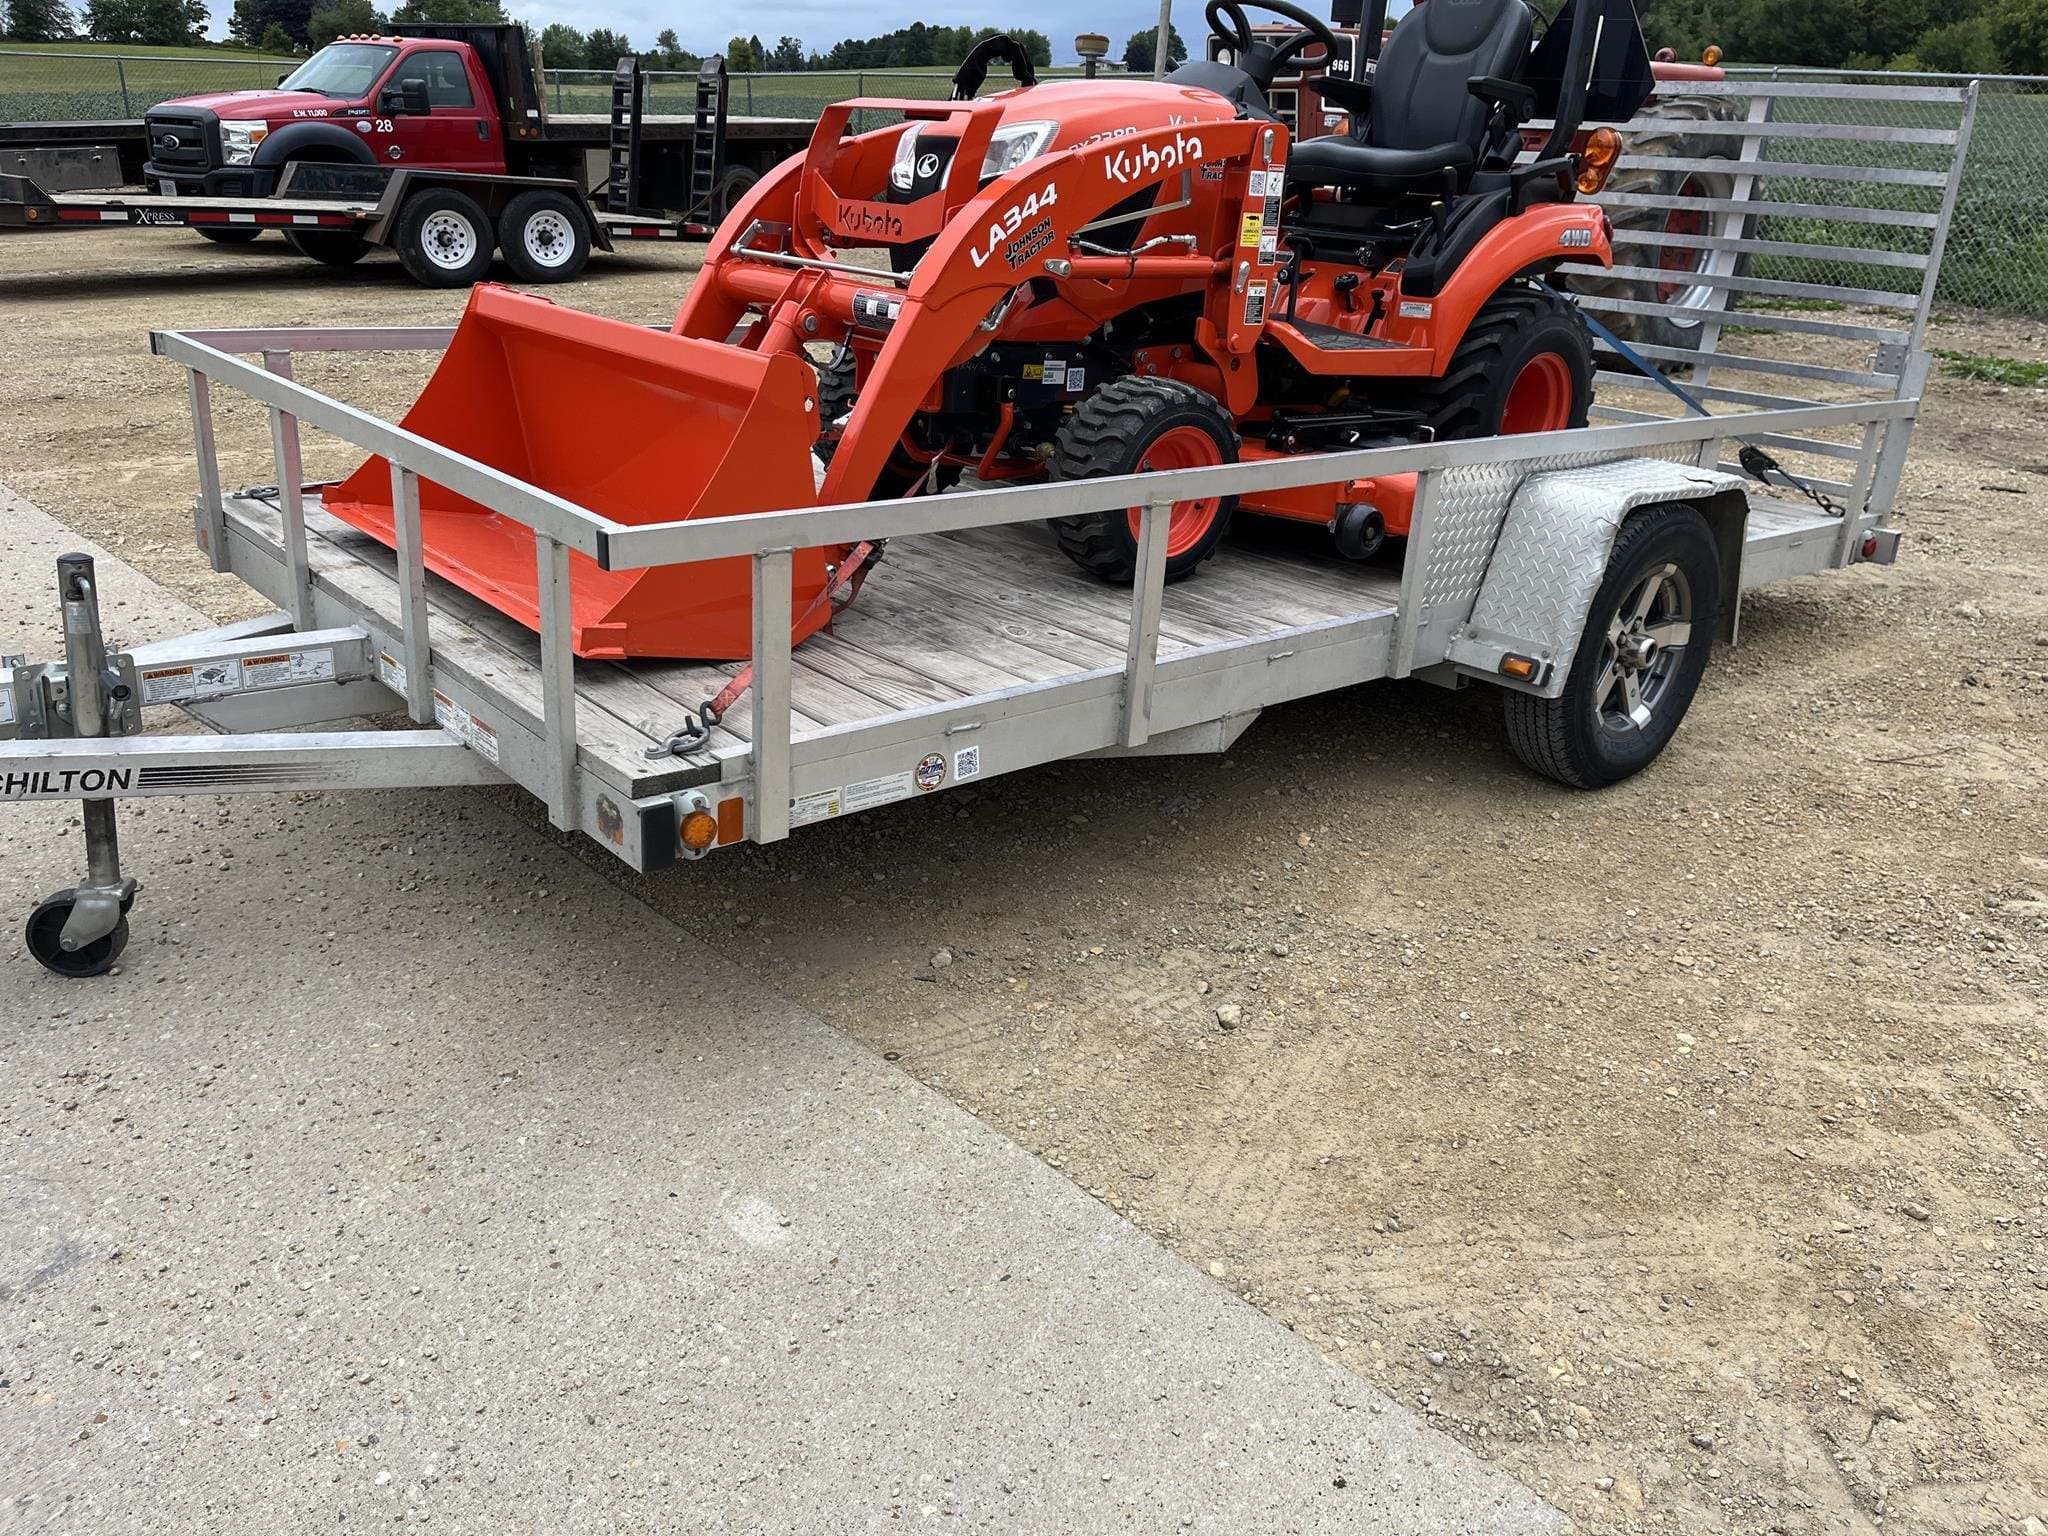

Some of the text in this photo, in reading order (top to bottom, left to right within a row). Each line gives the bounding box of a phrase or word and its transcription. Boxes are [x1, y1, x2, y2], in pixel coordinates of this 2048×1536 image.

[1332, 59, 1350, 72] 966
[375, 119, 394, 133] 28
[1104, 132, 1203, 183] Kubota
[838, 204, 904, 237] Kubota
[970, 182, 1058, 268] LA344
[1005, 216, 1051, 259] JOHNSON
[1008, 231, 1055, 271] TRACTOR
[1558, 228, 1592, 247] 4WD
[0, 768, 132, 795] HILTON
